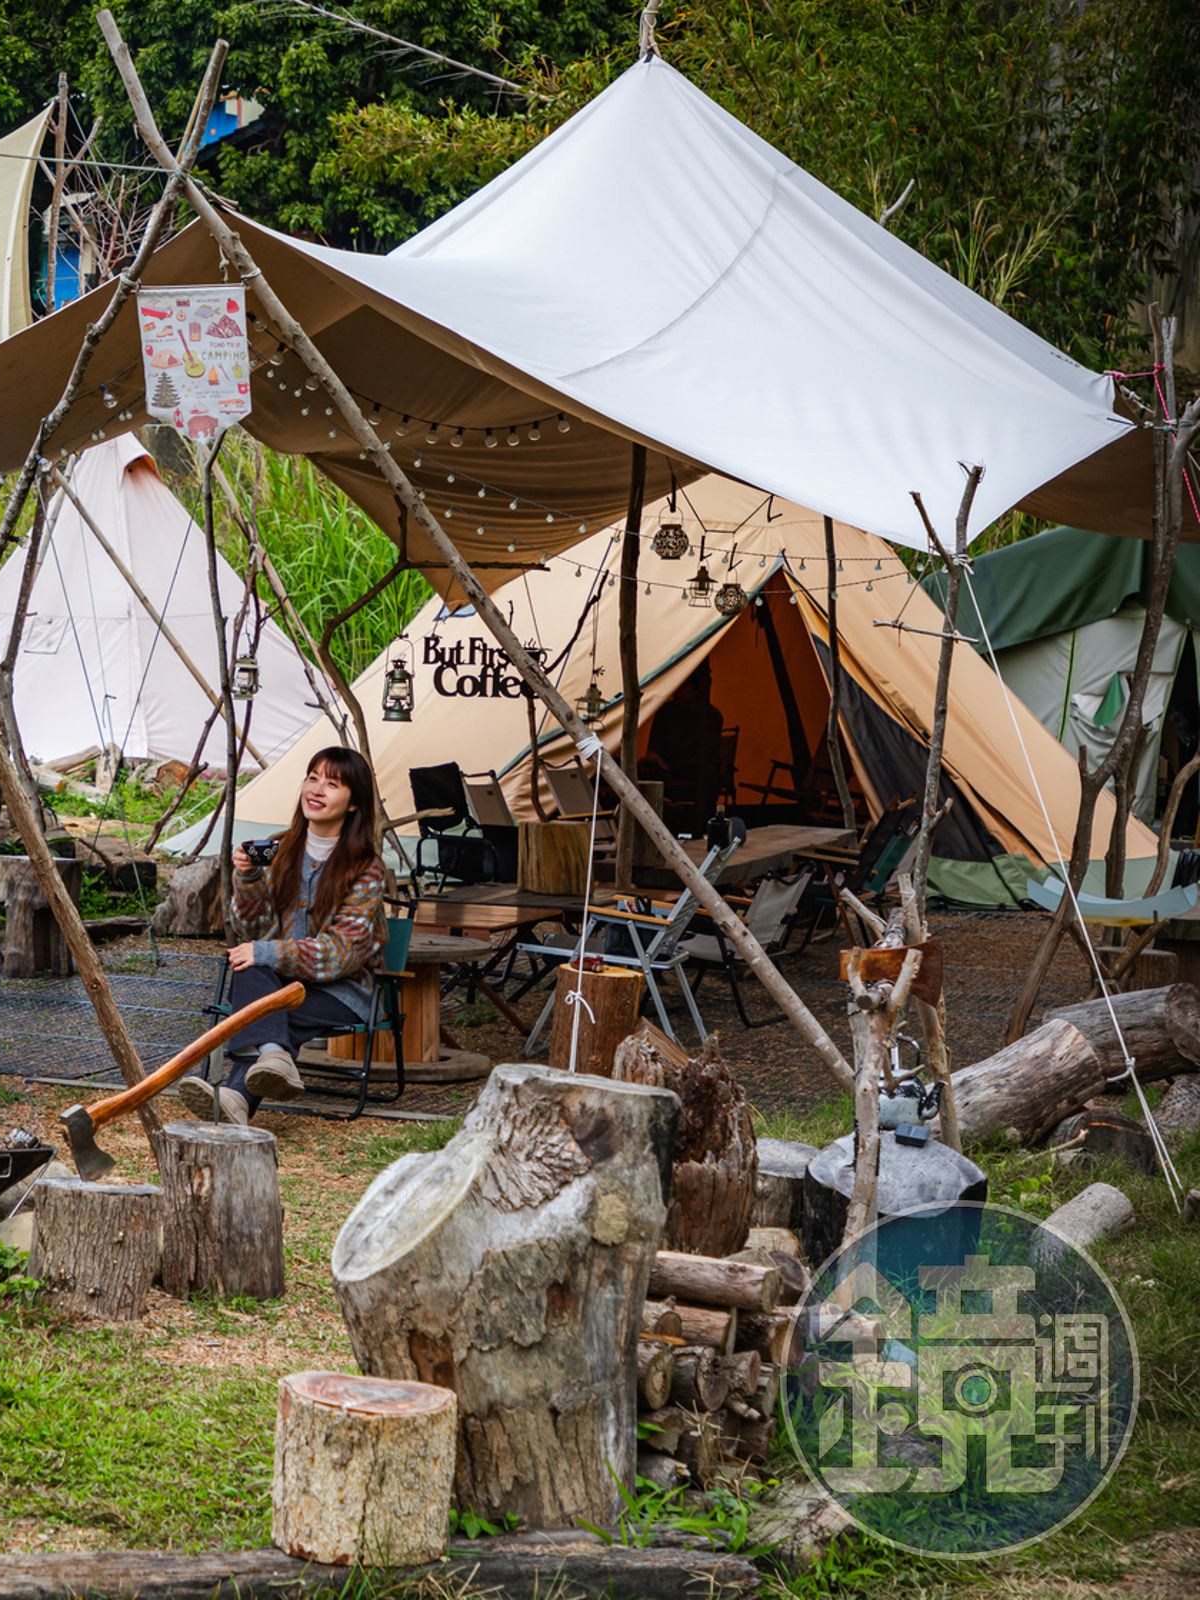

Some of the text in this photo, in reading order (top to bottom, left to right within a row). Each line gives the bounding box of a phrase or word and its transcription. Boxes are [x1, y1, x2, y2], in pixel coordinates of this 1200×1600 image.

[201, 351, 246, 361] CAMPING
[422, 636, 516, 666] But Firs
